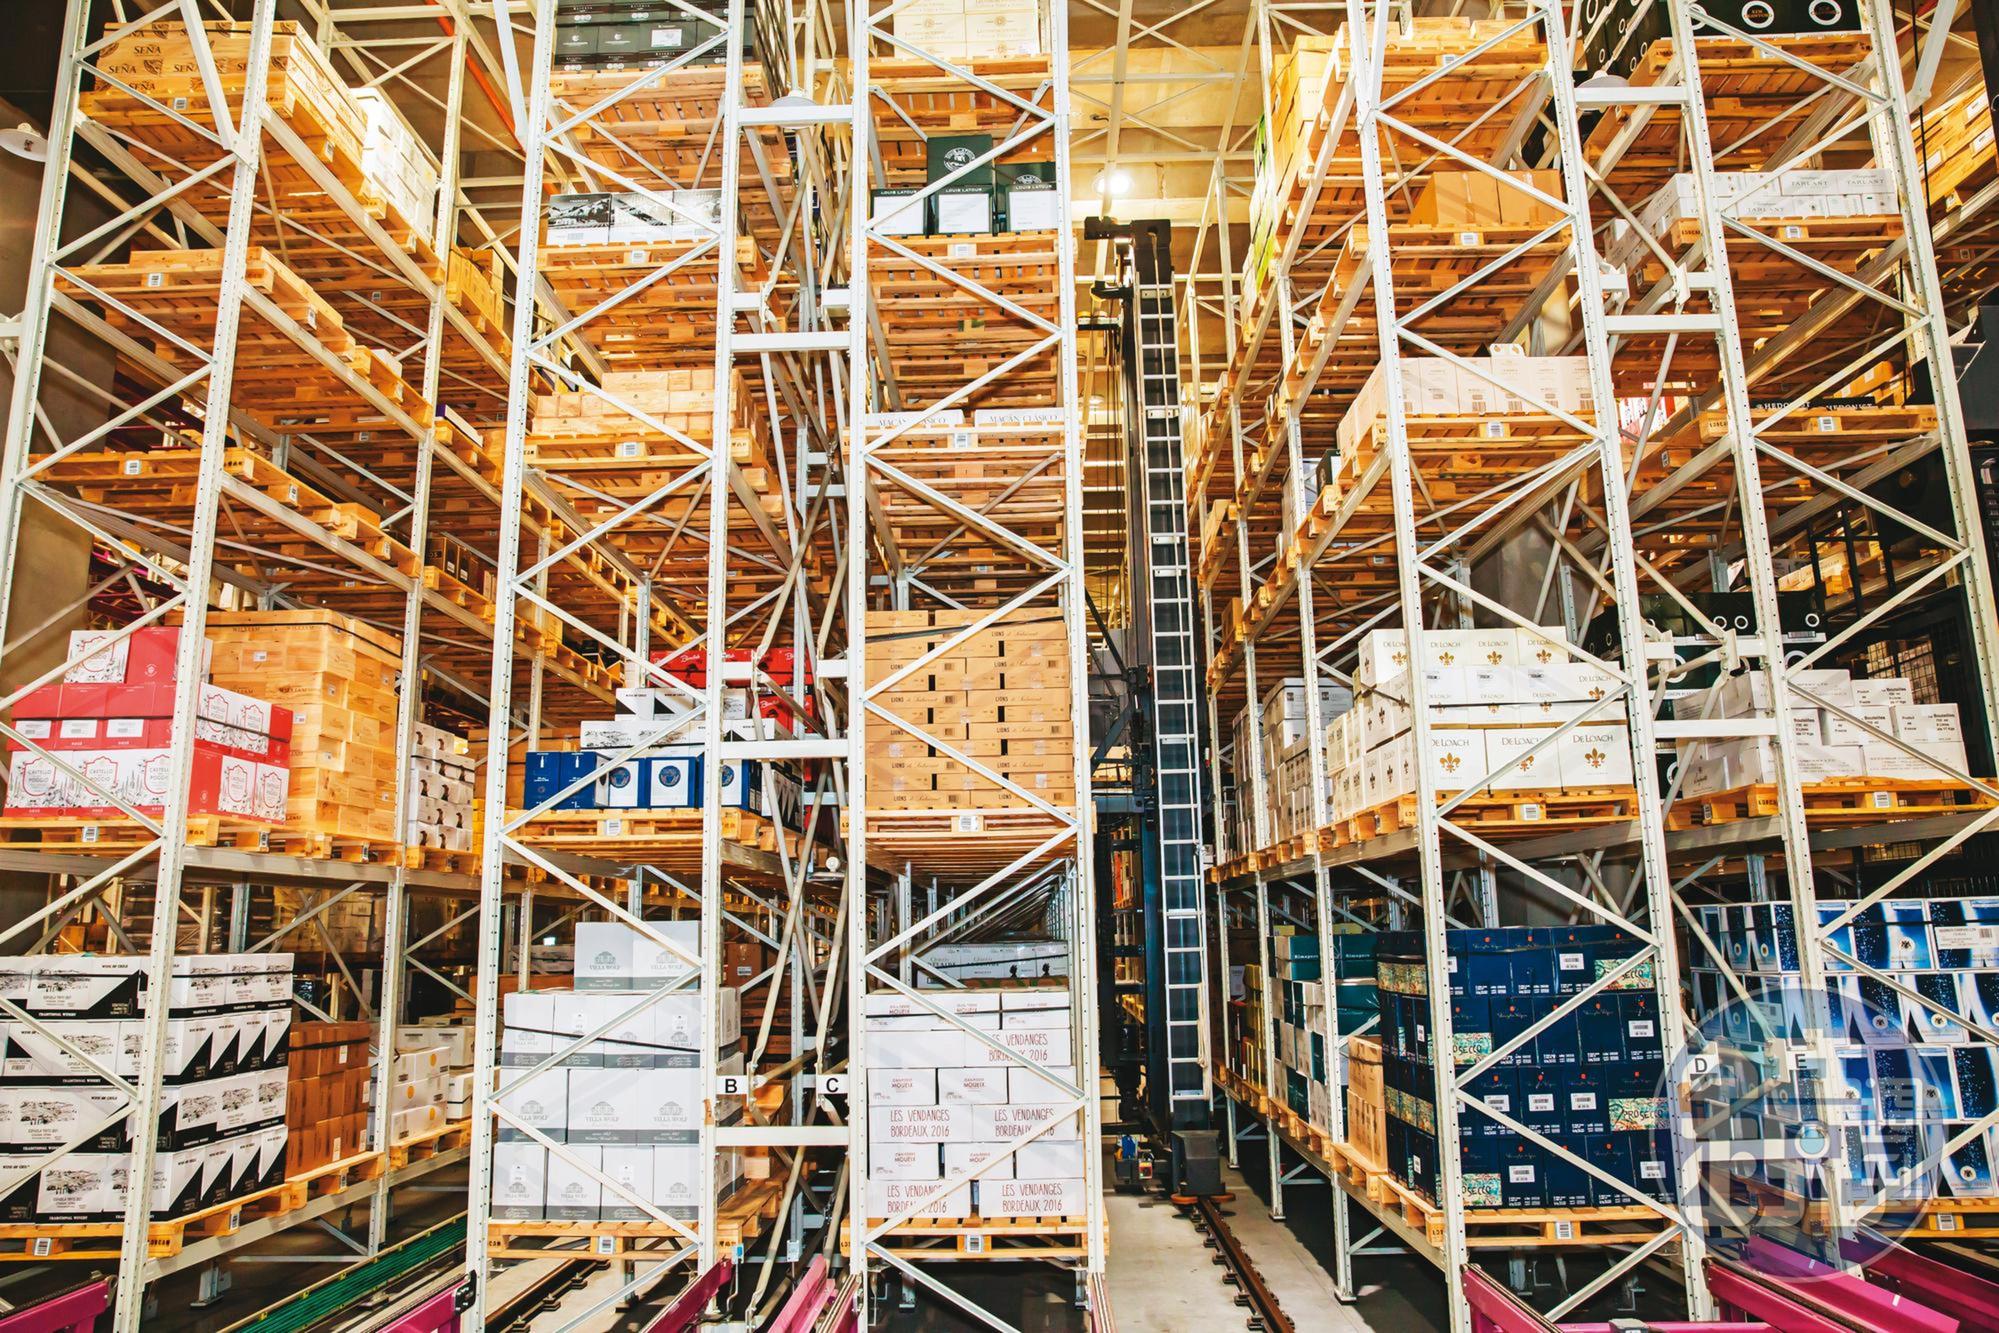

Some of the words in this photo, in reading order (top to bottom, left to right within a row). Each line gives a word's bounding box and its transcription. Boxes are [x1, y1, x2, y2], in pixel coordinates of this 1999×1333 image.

[1007, 1034, 1048, 1046] VENDANGES
[1030, 1049, 1048, 1061] 2016
[1452, 1045, 1482, 1054] OSECCO
[1695, 1058, 1707, 1072] D
[1795, 1054, 1807, 1068] E
[725, 1079, 738, 1093] B
[826, 1078, 839, 1094] C
[890, 1110, 903, 1122] LES
[907, 1109, 950, 1122] VENDANGES
[994, 1110, 1007, 1122] LES
[1623, 1109, 1663, 1121] PROSECCO
[890, 1125, 928, 1137] BORDEAUX
[931, 1124, 950, 1137] 2016
[888, 1186, 900, 1198] LES
[1002, 1184, 1015, 1197] LES
[1020, 1183, 1062, 1196] VENDANGES
[1462, 1186, 1492, 1196] OSECCO
[927, 1200, 947, 1213] 2016
[1002, 1200, 1041, 1213] BORDEAUX
[1044, 1200, 1062, 1212] 2016
